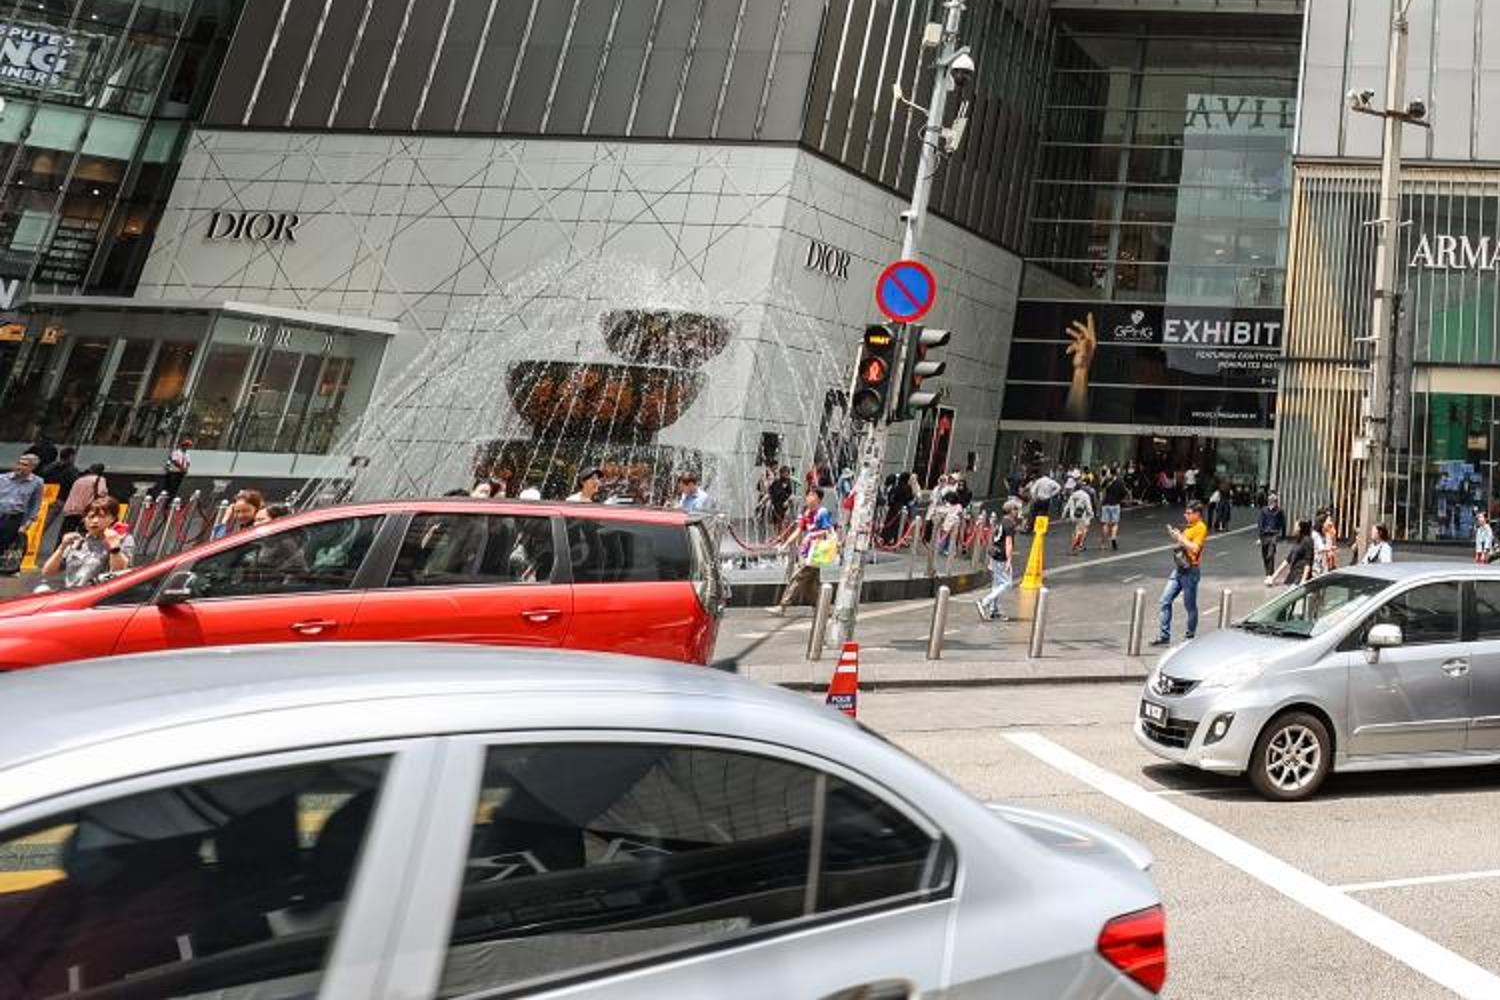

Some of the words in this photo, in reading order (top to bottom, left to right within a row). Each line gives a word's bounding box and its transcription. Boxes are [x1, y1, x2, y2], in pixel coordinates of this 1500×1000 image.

[206, 211, 300, 243] DIOR
[806, 239, 851, 281] DIOR
[1162, 319, 1281, 345] EXHIBIT
